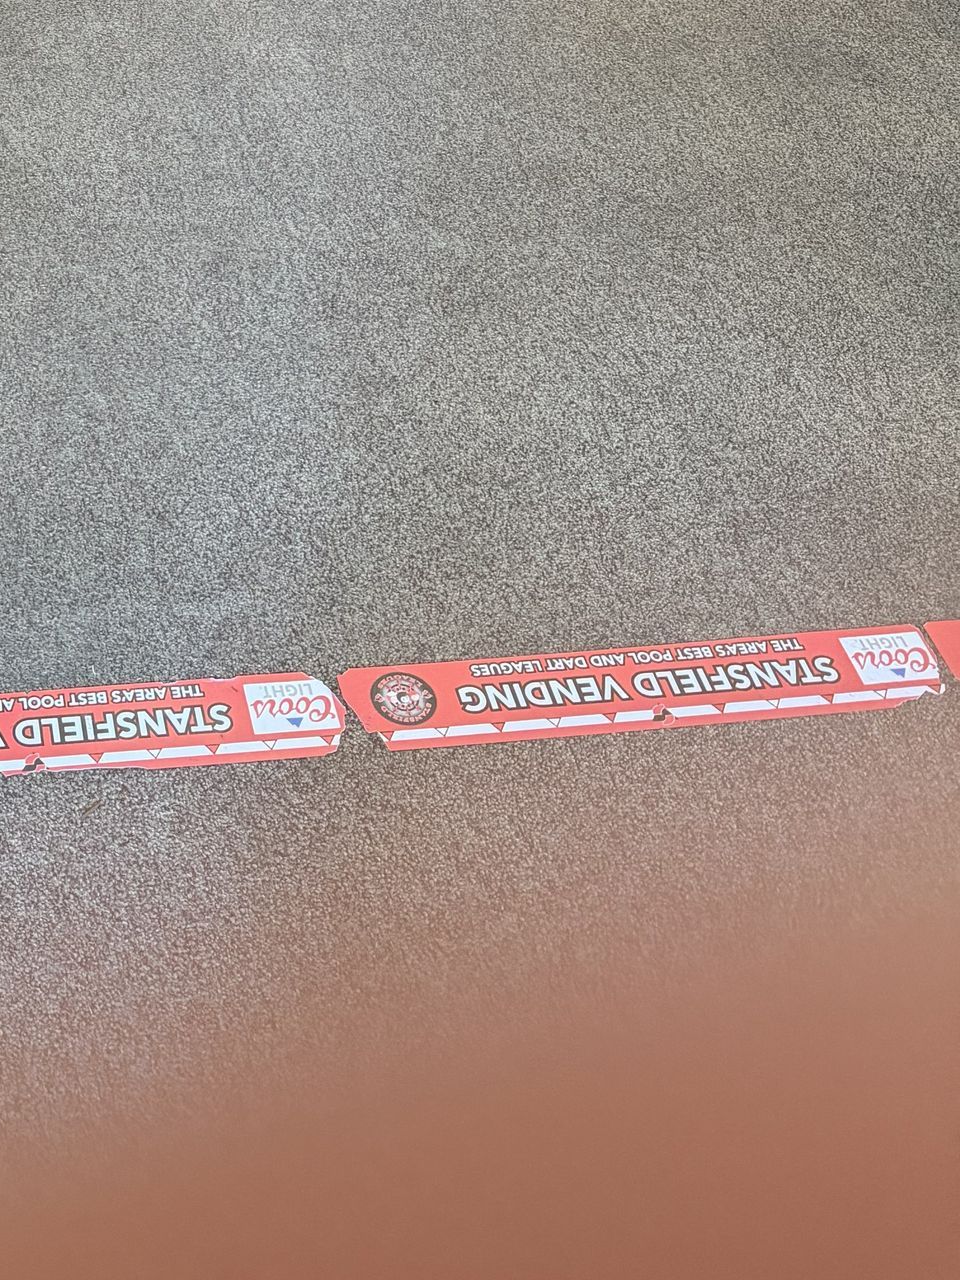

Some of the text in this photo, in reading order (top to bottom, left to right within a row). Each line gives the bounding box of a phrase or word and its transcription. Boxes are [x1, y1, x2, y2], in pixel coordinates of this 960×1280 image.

[859, 636, 908, 650] LIGHT
[470, 637, 804, 676] THE AREA'S BEST POOL AND DART LEAGUES
[851, 647, 935, 672] Coors
[169, 685, 203, 700] THE
[264, 683, 312, 698] LIGHT
[457, 656, 839, 713] STANSFIELD VENDING
[17, 694, 65, 711] POOL
[67, 691, 107, 707] BEST
[111, 687, 166, 704] AREA'S
[250, 696, 335, 722] Coors
[15, 703, 231, 747] STANSFIELD
